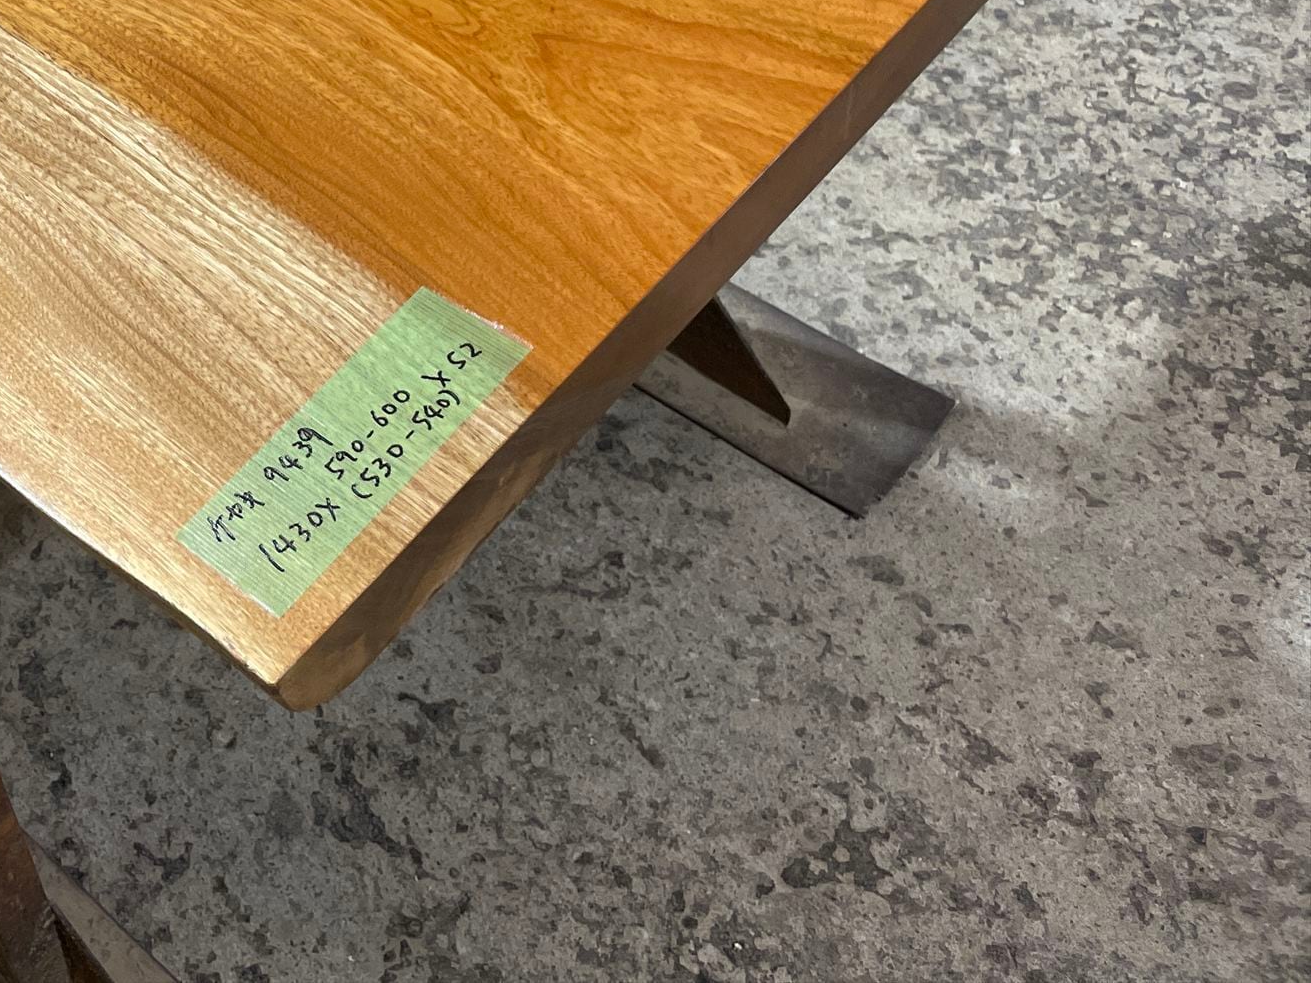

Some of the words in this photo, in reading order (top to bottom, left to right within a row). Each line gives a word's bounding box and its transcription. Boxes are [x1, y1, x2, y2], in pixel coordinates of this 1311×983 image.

[264, 427, 334, 482] 9439
[325, 389, 411, 480] 590-600
[351, 390, 461, 499] (530-540)
